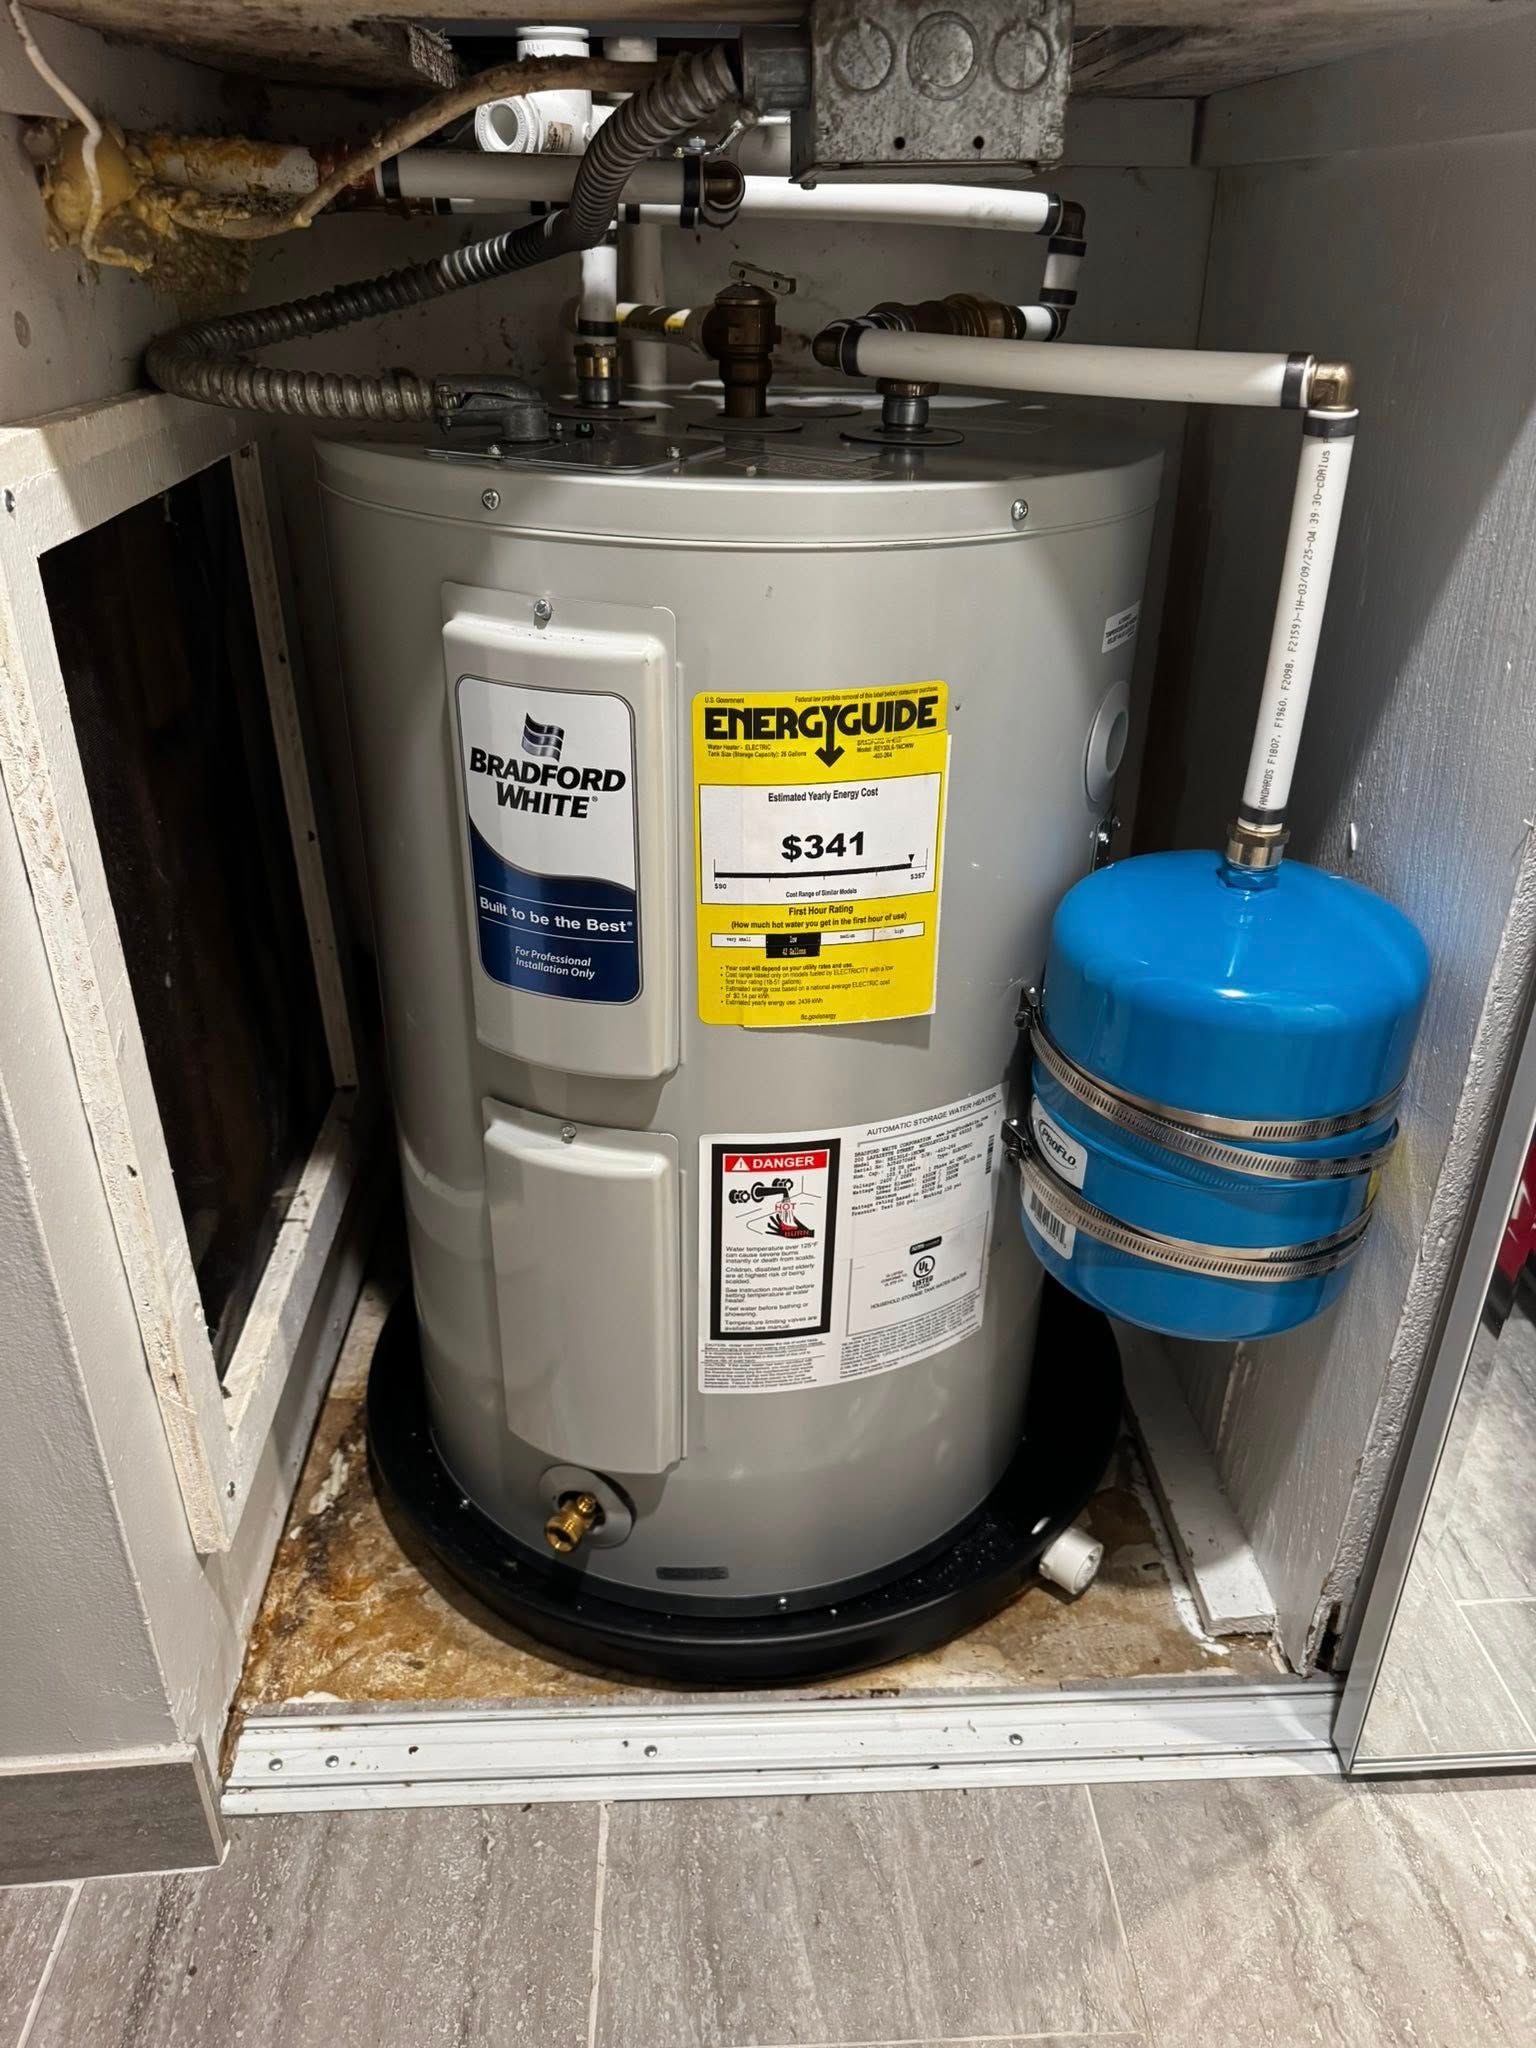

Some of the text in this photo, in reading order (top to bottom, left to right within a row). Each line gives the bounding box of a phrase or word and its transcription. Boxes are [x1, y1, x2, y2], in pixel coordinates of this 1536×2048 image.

[1274, 698, 1288, 728] F1960,
[1281, 659, 1294, 691] F2098,
[704, 696, 938, 740] ENERGYGUIDE
[469, 747, 626, 792] BRADFORD
[768, 787, 879, 802] Estimated Yearly Energy Cost
[781, 831, 864, 863] $341
[799, 890, 814, 899] Range
[822, 888, 839, 897] Similar
[840, 887, 857, 895] Models
[480, 896, 508, 917] Built
[511, 907, 526, 920] to
[530, 911, 549, 926] be
[554, 915, 581, 930] the
[789, 905, 854, 916] First Hour Rating
[731, 921, 749, 930] (How
[751, 921, 770, 929] much
[772, 921, 784, 929] hot
[820, 919, 831, 928] get
[832, 918, 839, 926] in
[853, 916, 867, 924] first
[868, 915, 884, 923] hour
[892, 912, 907, 921] use)
[514, 945, 591, 967] For Professional
[516, 957, 595, 980] Installation Only
[834, 967, 869, 976] ELECTRICITY
[852, 980, 878, 988] ELECTRIC
[866, 1092, 997, 1136] AUTOMATIC STORAGE WATER HEATER
[1041, 1128, 1076, 1166] PROFLO
[752, 1156, 815, 1168] DANGER
[774, 1202, 798, 1211] HOT
[784, 1230, 810, 1238] BURN
[725, 1257, 751, 1265] instantly
[918, 1260, 930, 1273] UL
[744, 1271, 768, 1279] highest
[912, 1275, 934, 1288] LISTED
[779, 1302, 801, 1310] bathing
[870, 1297, 900, 1309] HOUSEHOLD
[901, 1290, 923, 1302] STORAGE
[725, 1319, 764, 1327] Temperature
